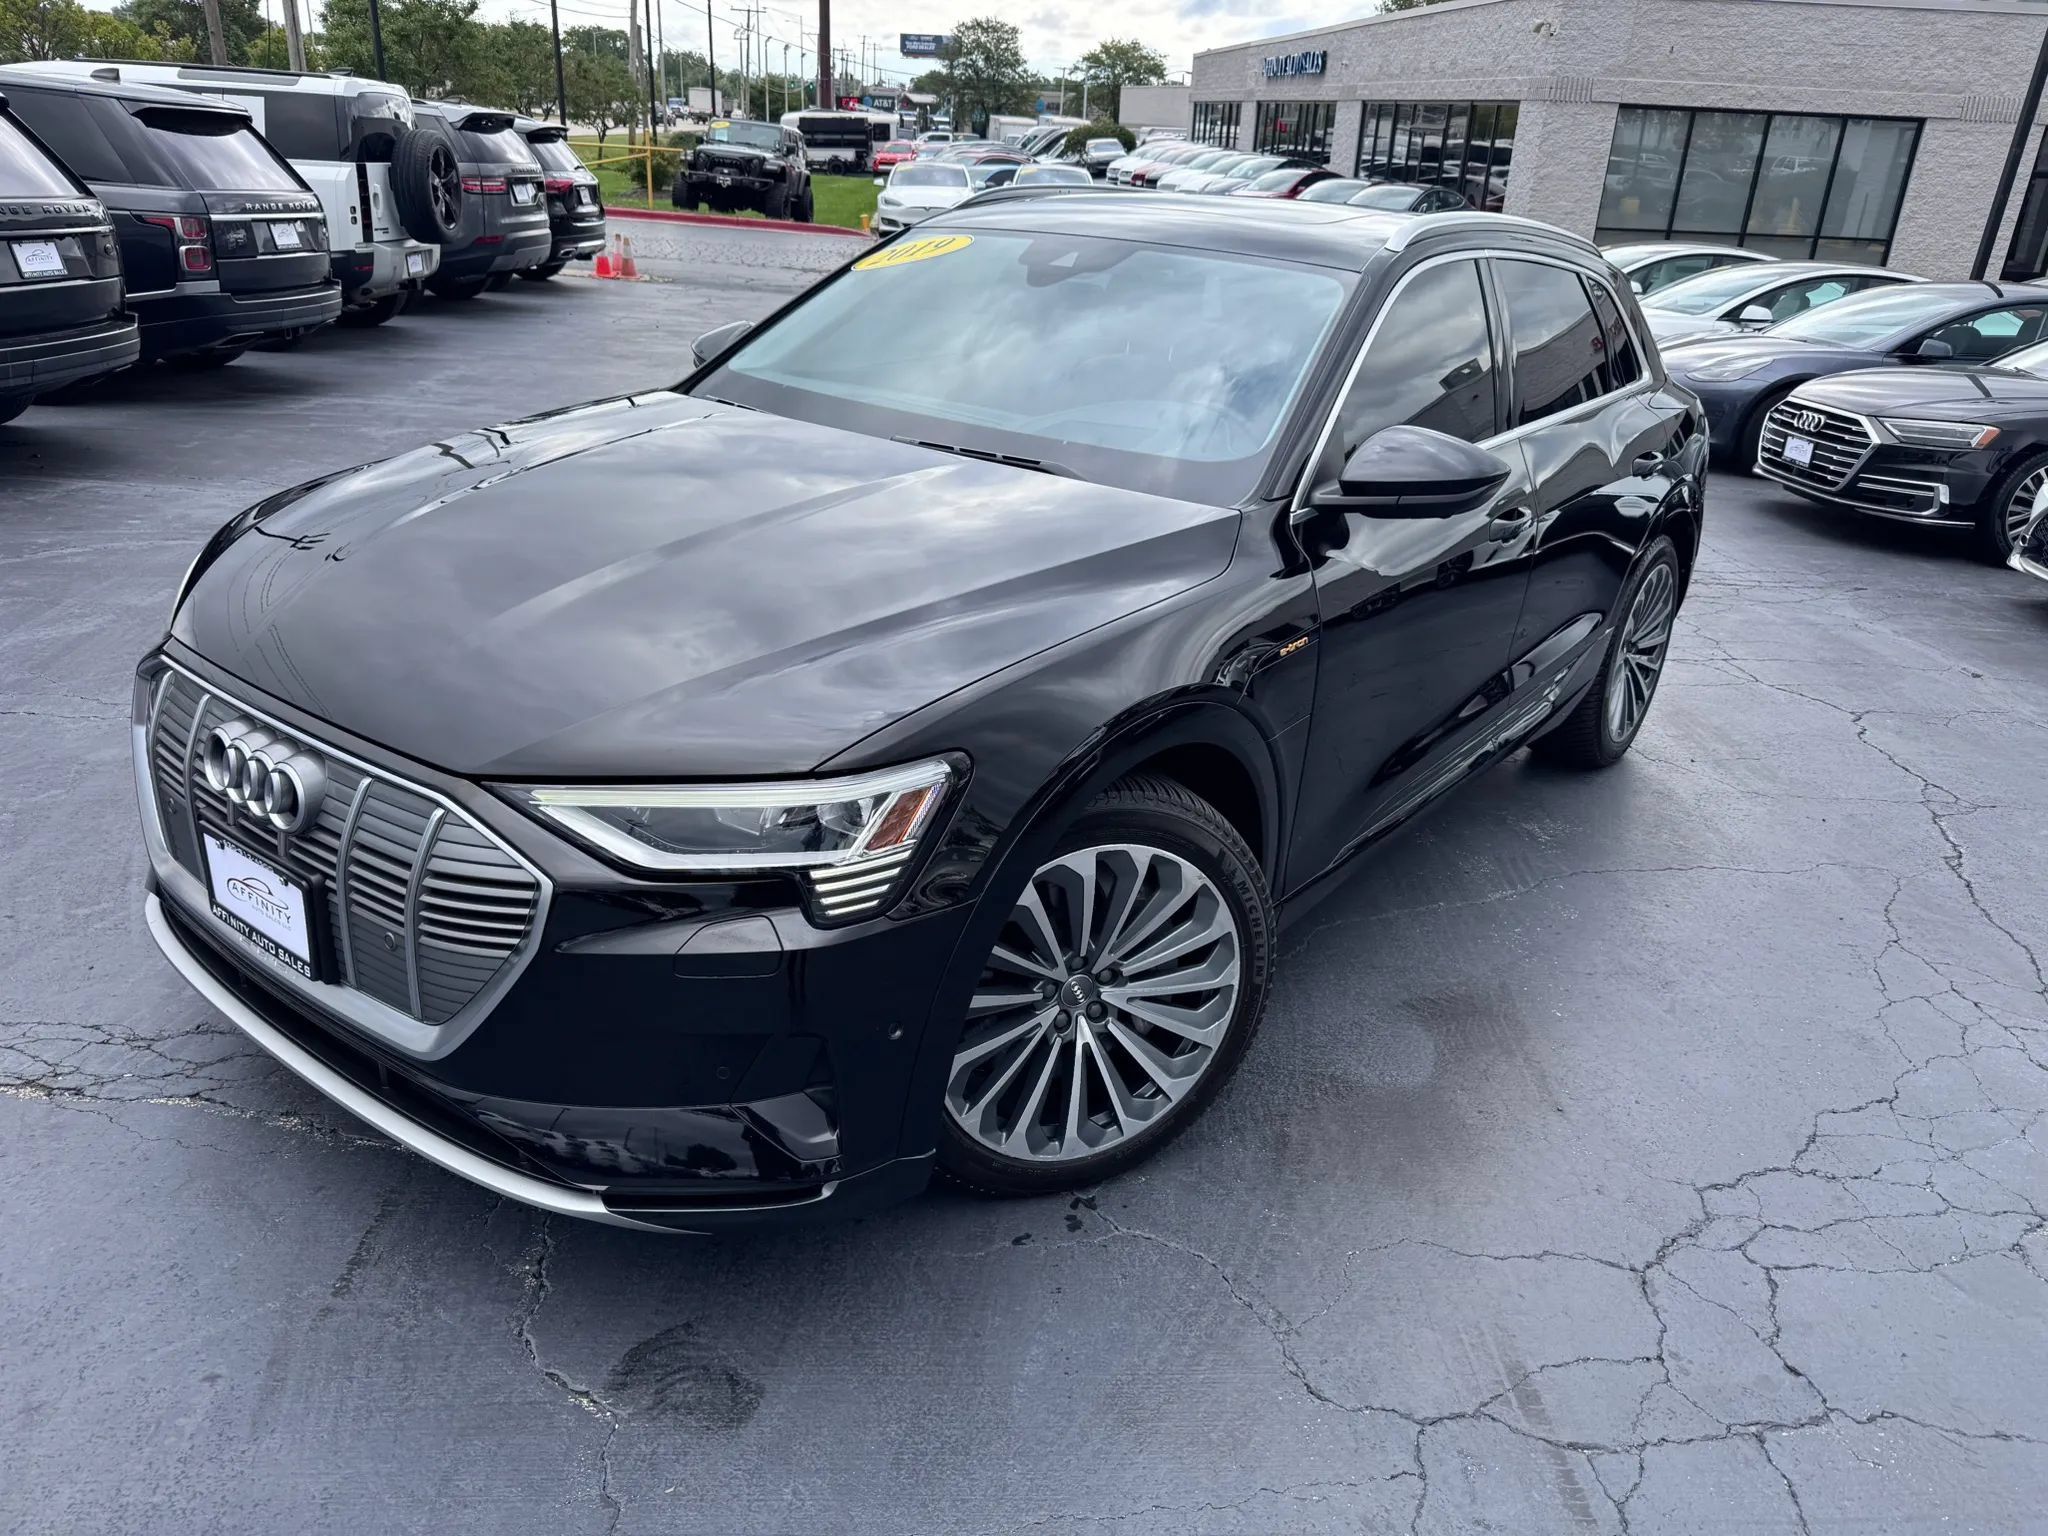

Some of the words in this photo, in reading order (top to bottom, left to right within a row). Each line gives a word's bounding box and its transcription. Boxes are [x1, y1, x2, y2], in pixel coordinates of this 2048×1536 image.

[873, 98, 893, 108] AT&T
[42, 204, 91, 214] ROVER
[245, 202, 284, 210] RANGE
[289, 200, 320, 210] ROVER
[864, 238, 956, 266] 2019
[1280, 636, 1308, 656] e-tron
[232, 882, 291, 924] AFFINITY
[1237, 880, 1266, 977] MICHELIN
[212, 904, 249, 937] AFFINITY
[251, 931, 276, 955] AUTO
[278, 948, 311, 978] SALES
